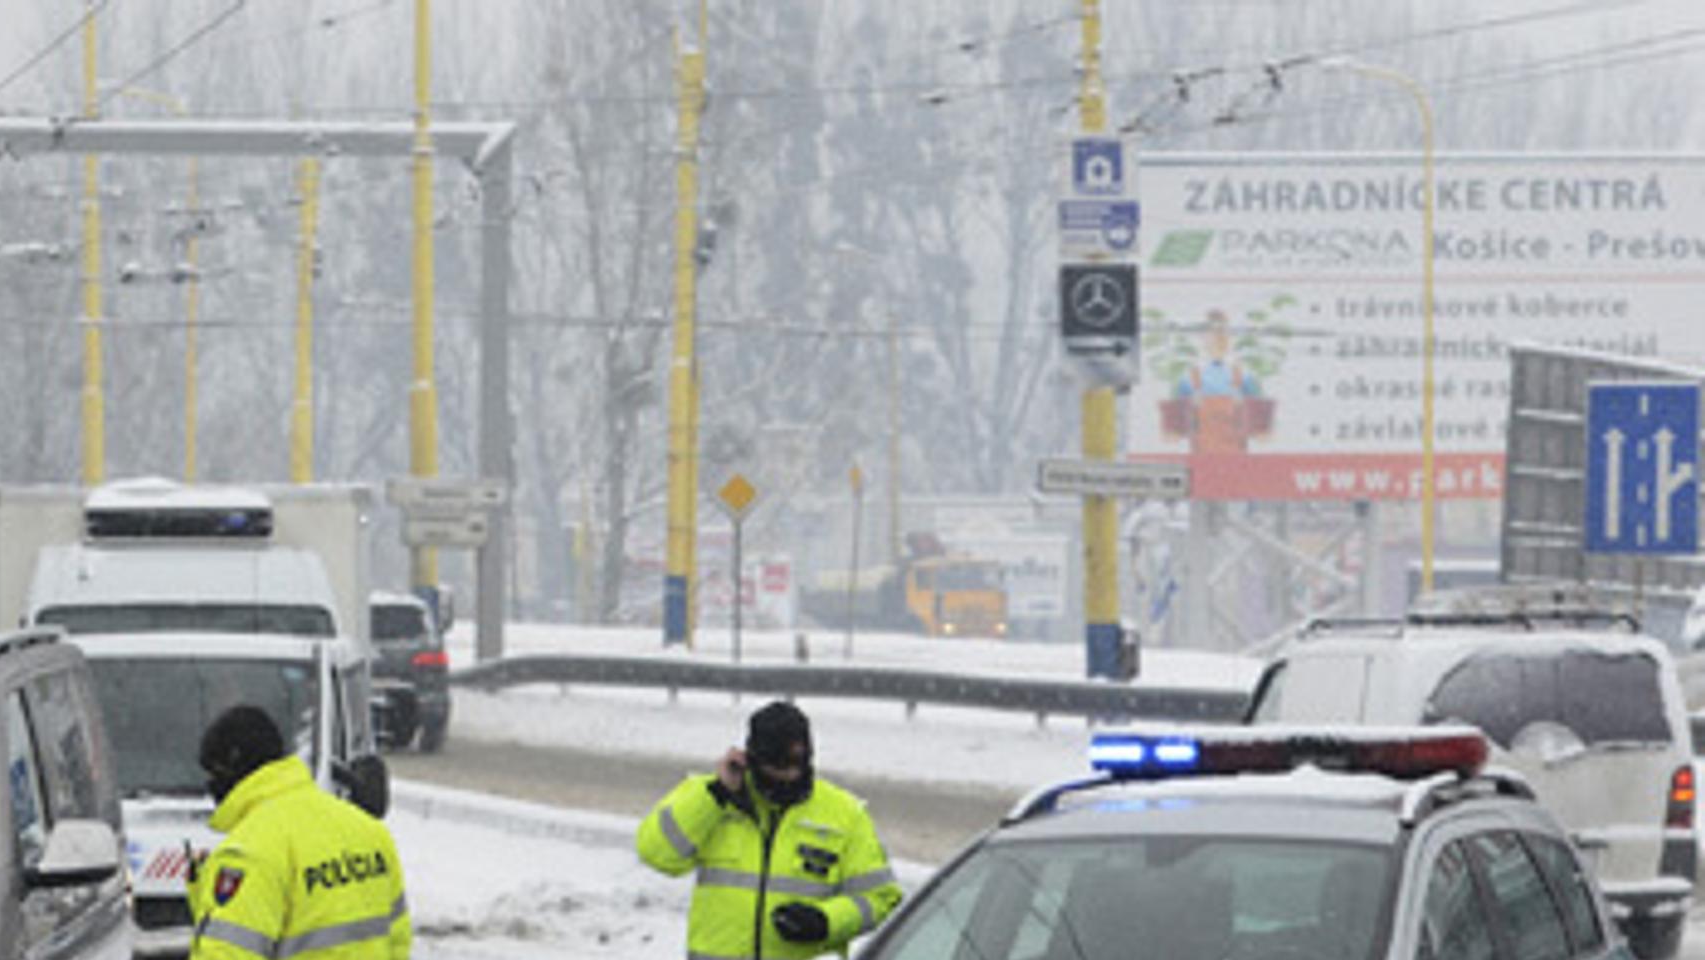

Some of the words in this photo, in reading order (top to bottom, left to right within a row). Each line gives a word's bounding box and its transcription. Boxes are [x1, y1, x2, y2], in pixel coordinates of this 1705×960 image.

[1184, 172, 1489, 212] ZÁHRADNÍCKE
[1500, 172, 1668, 211] CENTRÁ
[1221, 228, 1411, 256] PARKONA
[1433, 228, 1552, 260] Košice
[1506, 294, 1629, 318] koberce
[1335, 333, 1506, 358] záhraníck
[1335, 374, 1456, 401] okrasé
[304, 849, 388, 894] POLÍCIA
